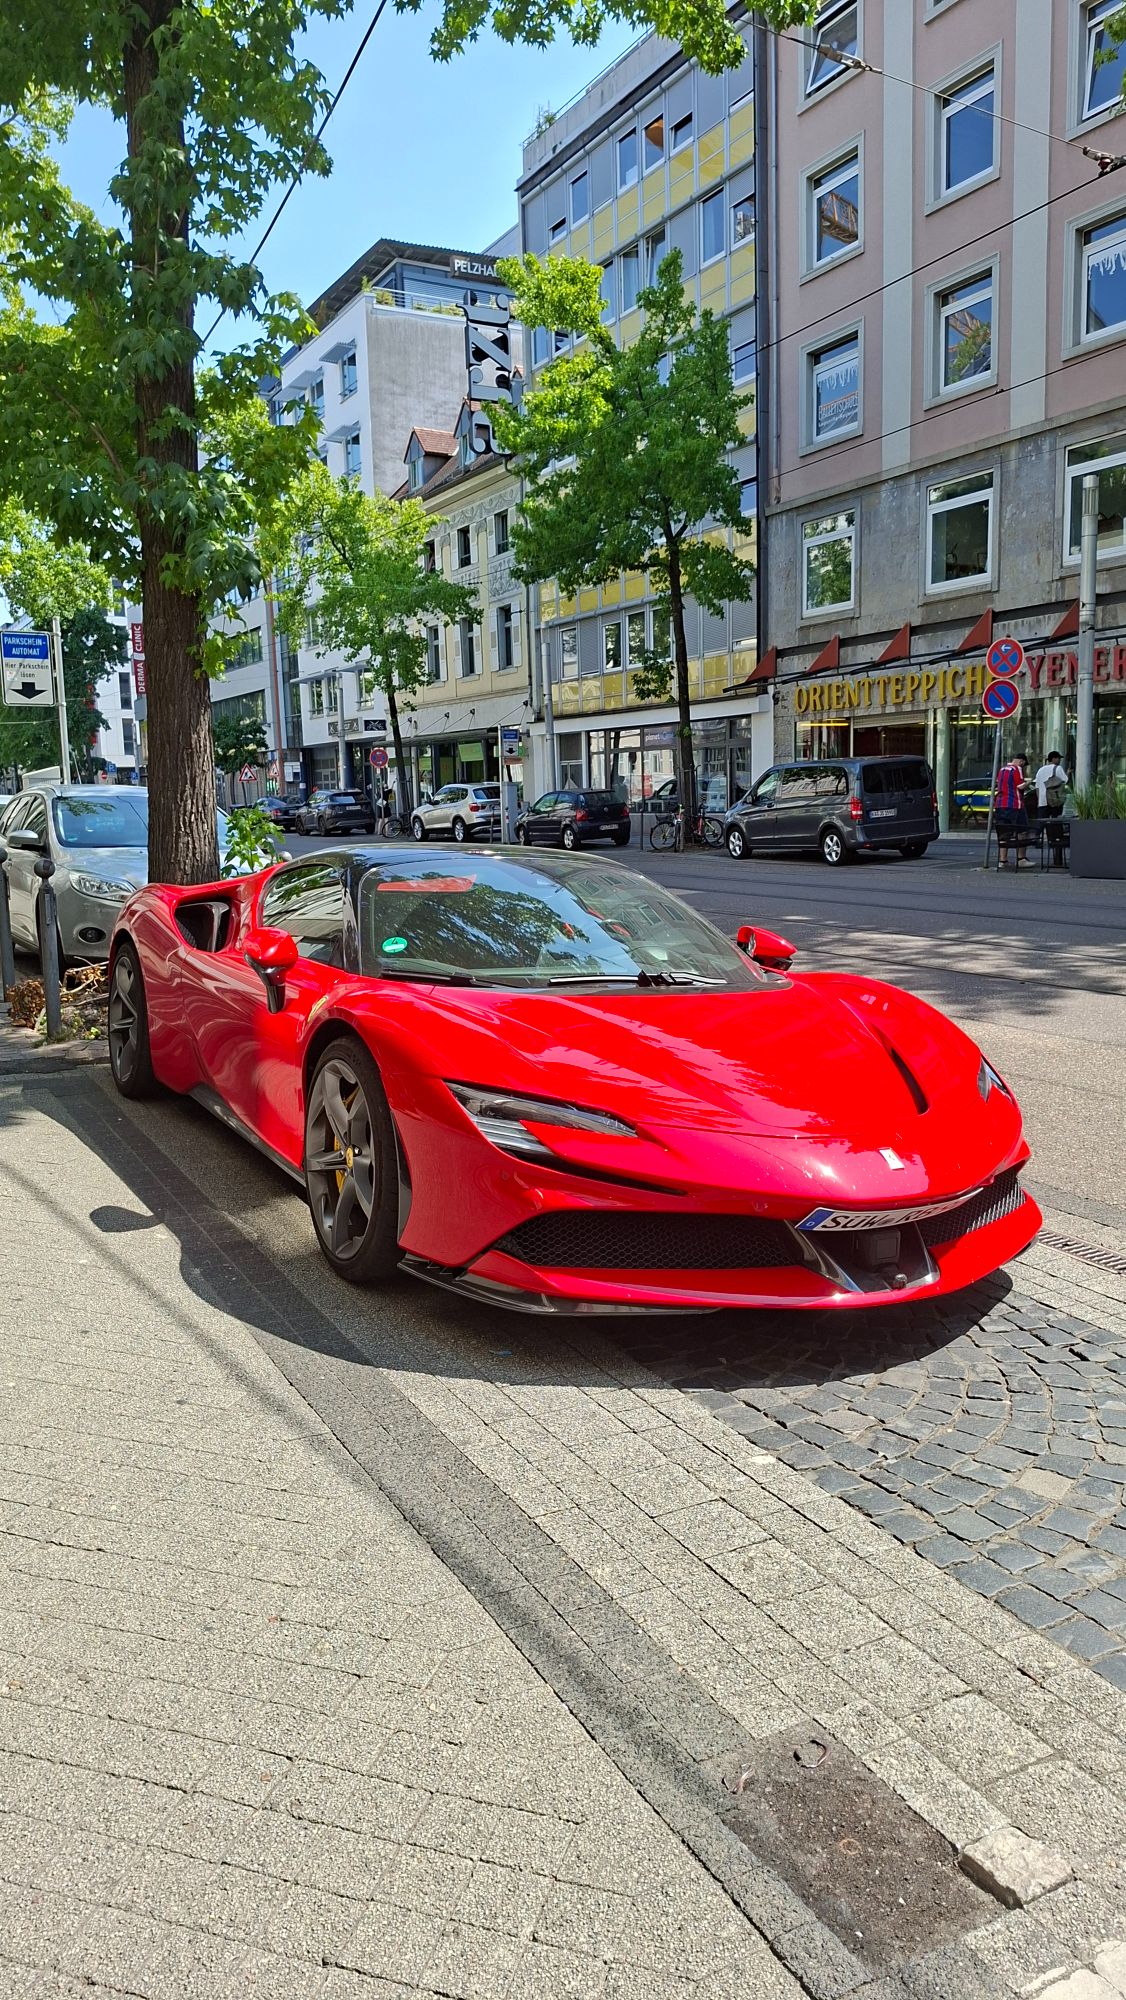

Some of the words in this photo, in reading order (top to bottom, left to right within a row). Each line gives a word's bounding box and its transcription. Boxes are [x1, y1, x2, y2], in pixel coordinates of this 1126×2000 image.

[4, 636, 46, 646] PARKSCHEIN-
[133, 625, 143, 652] CLINIC
[11, 647, 40, 656] AUTOMAT
[19, 662, 49, 670] Parkschein
[138, 662, 146, 692] DERMA
[794, 664, 993, 714] ORIENTTEPPICH
[821, 1214, 886, 1229] SÜW
